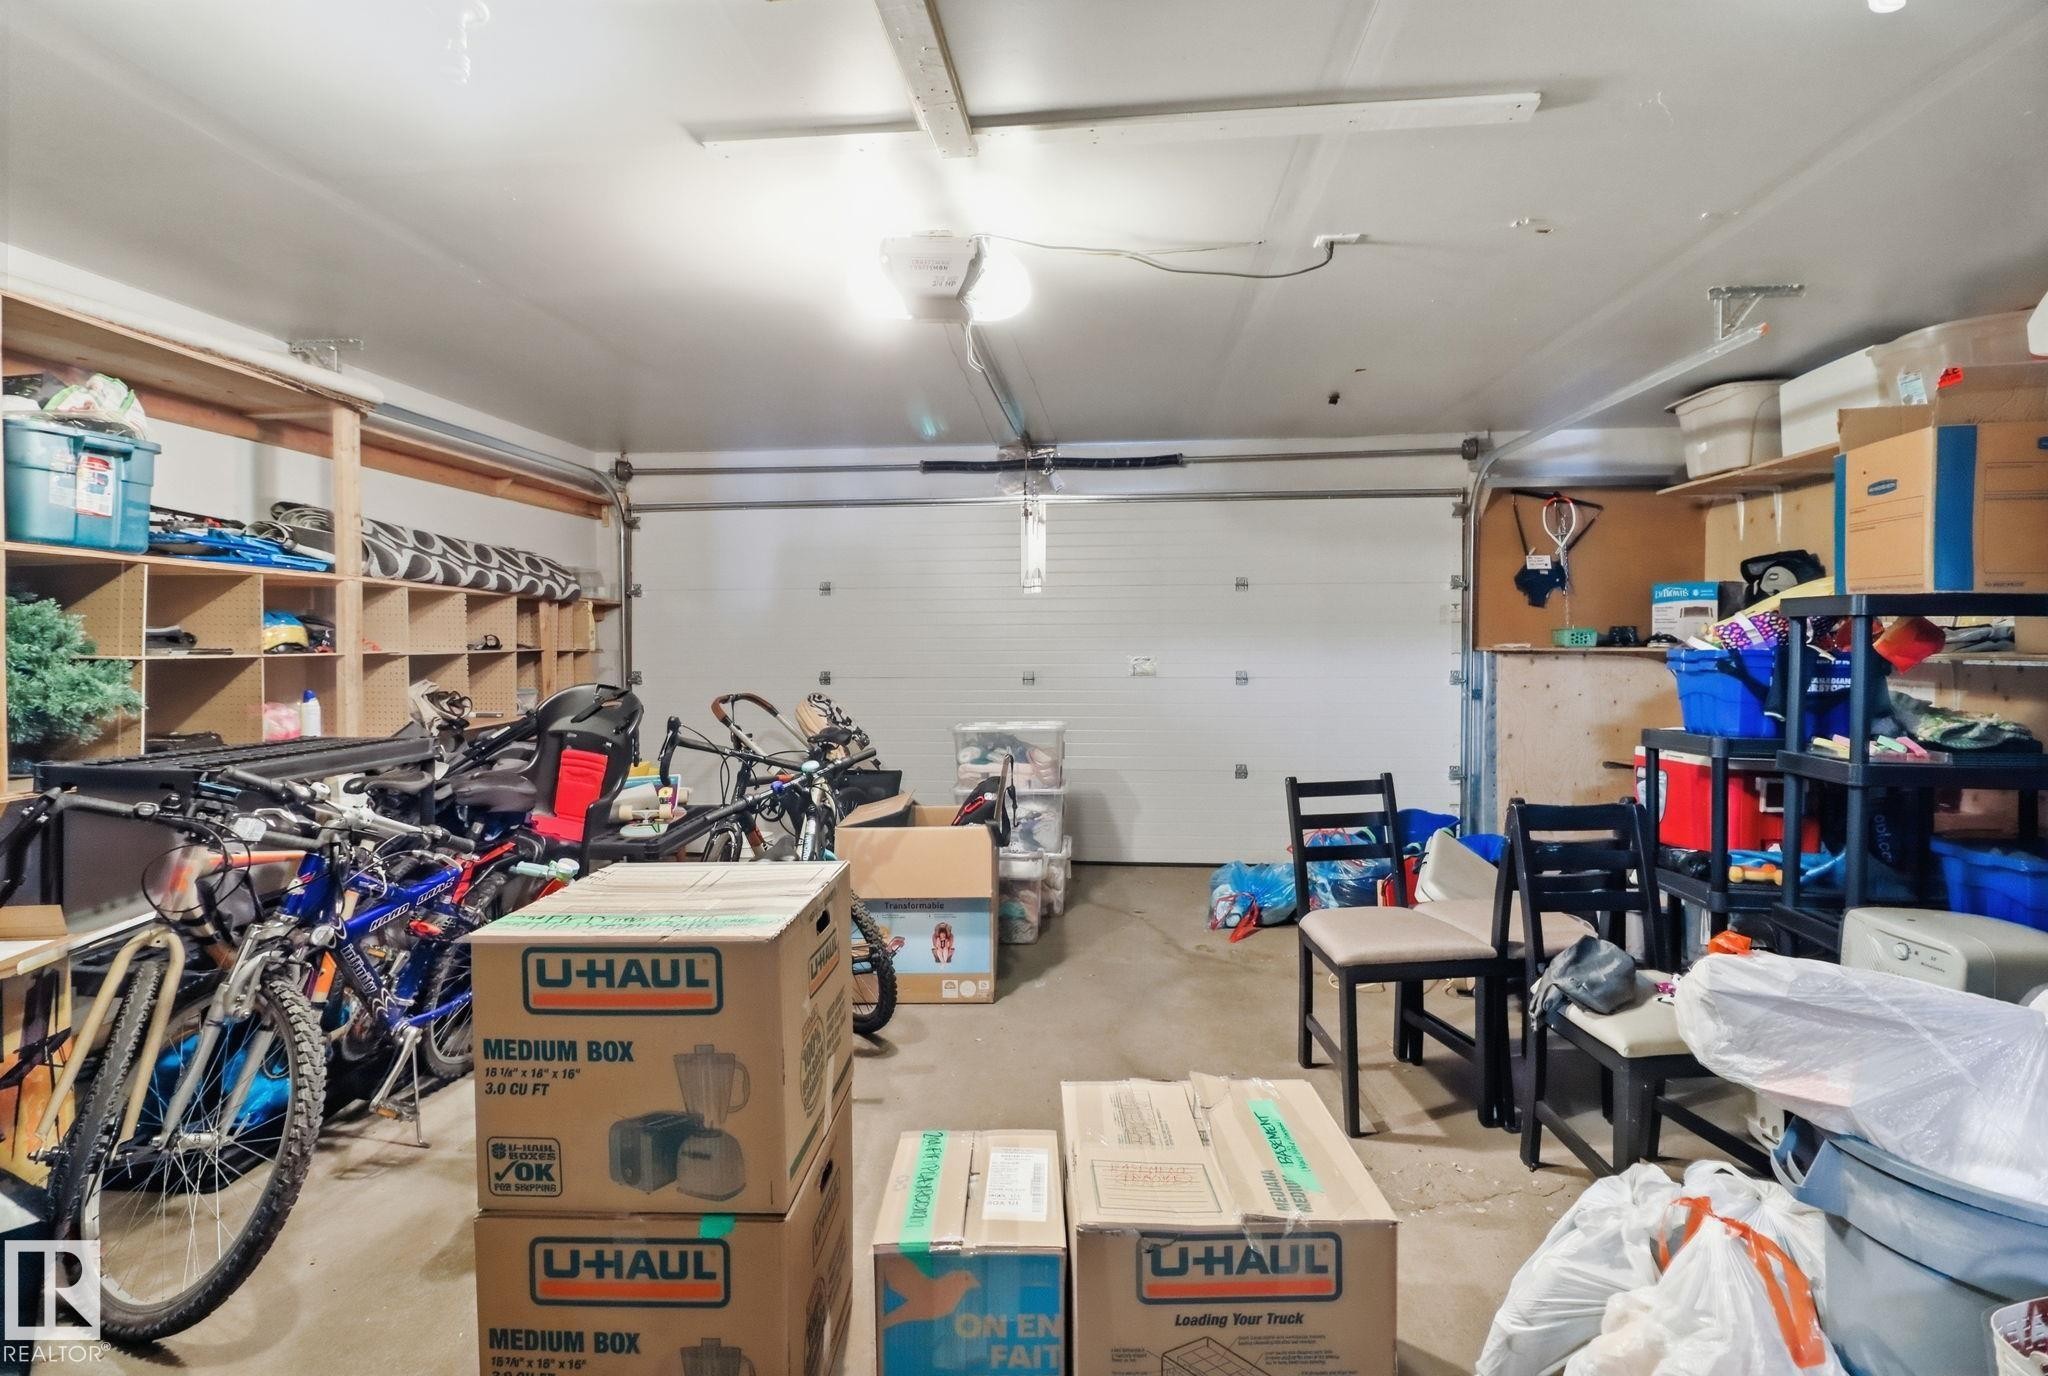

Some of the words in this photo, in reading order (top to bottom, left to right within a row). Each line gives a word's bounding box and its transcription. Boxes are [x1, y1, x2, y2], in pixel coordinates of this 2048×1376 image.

[884, 902, 945, 910] Transformable
[536, 957, 710, 989] U-HAUL
[483, 1038, 578, 1062] MEDIUM
[587, 1040, 634, 1062] BOX
[484, 1082, 506, 1095] 3.0
[509, 1082, 528, 1096] CU
[532, 1083, 550, 1096] FT
[1253, 1111, 1295, 1166] BASEMENT
[508, 1152, 556, 1160] BOXES
[514, 1162, 555, 1182] OK
[543, 1248, 717, 1281] U-HAUL
[1151, 1244, 1329, 1276] U-HAUL
[955, 1313, 1008, 1338] ON
[1174, 1313, 1228, 1328] Loading
[1232, 1312, 1262, 1326] Your
[1267, 1312, 1305, 1326] Truck
[489, 1327, 585, 1353] MEDIUM
[593, 1331, 641, 1355] BOX
[990, 1343, 1064, 1369] FAIT
